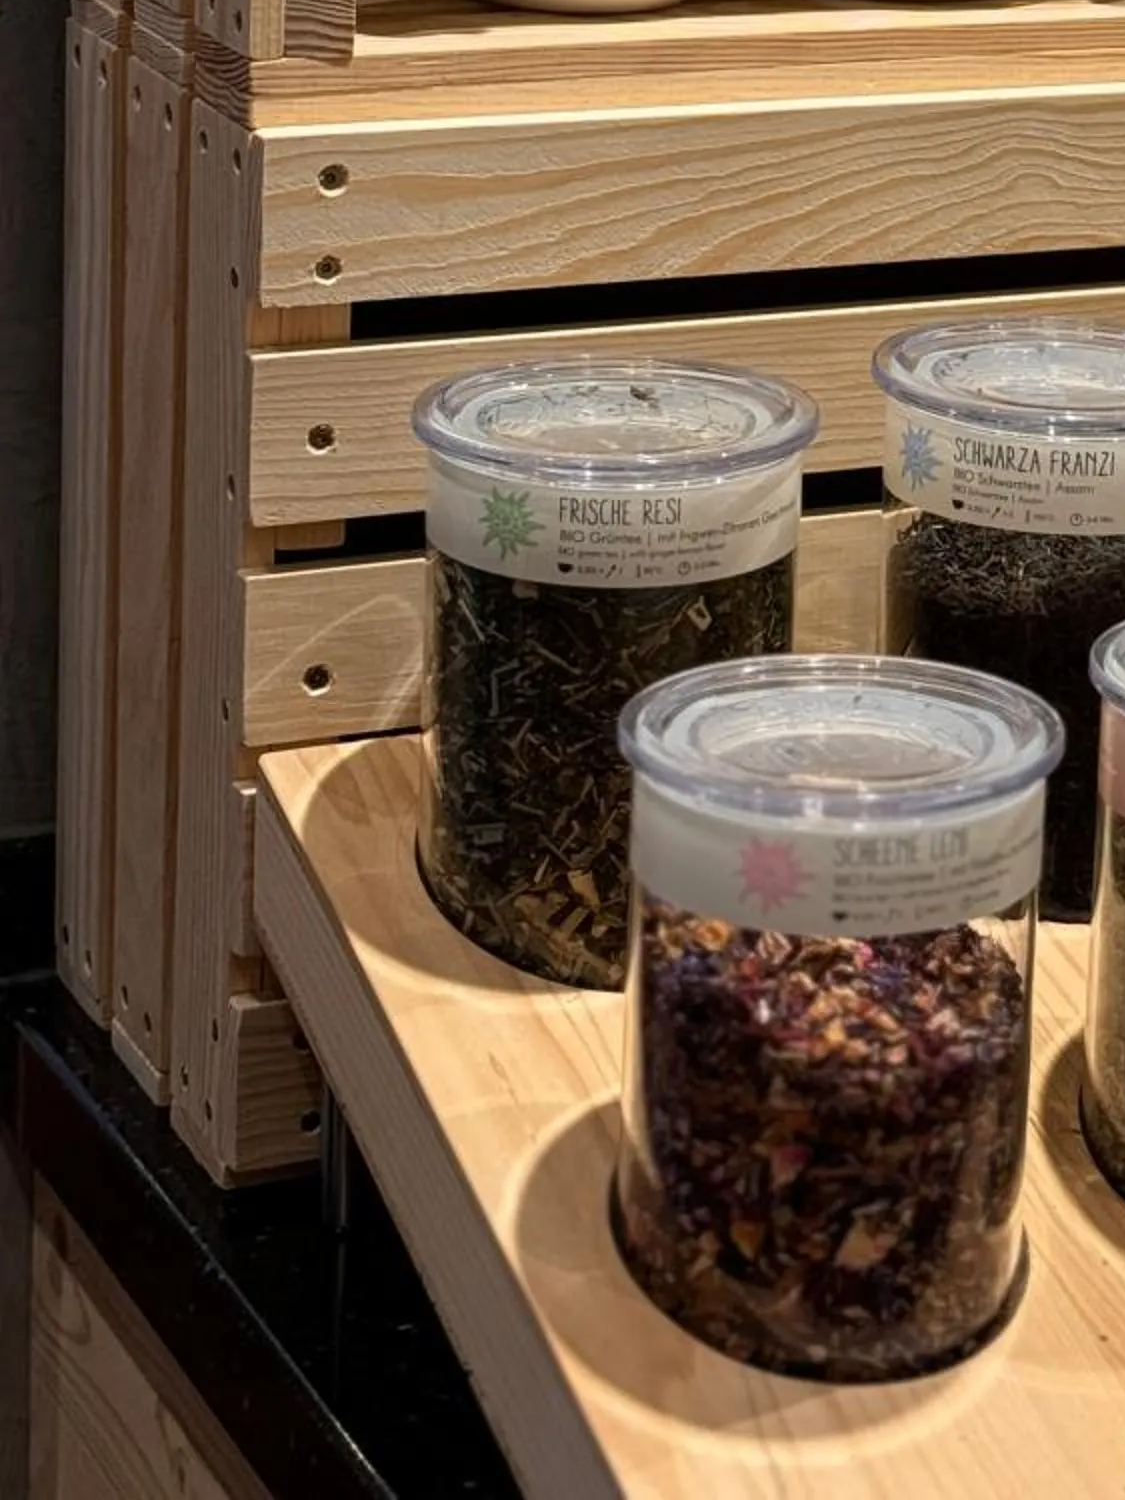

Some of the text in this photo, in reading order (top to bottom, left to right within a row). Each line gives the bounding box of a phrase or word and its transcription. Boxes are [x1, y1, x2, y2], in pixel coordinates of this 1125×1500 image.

[953, 436, 1115, 477] SCHWARZA FRANZI
[559, 497, 681, 526] FRISCHE RESI
